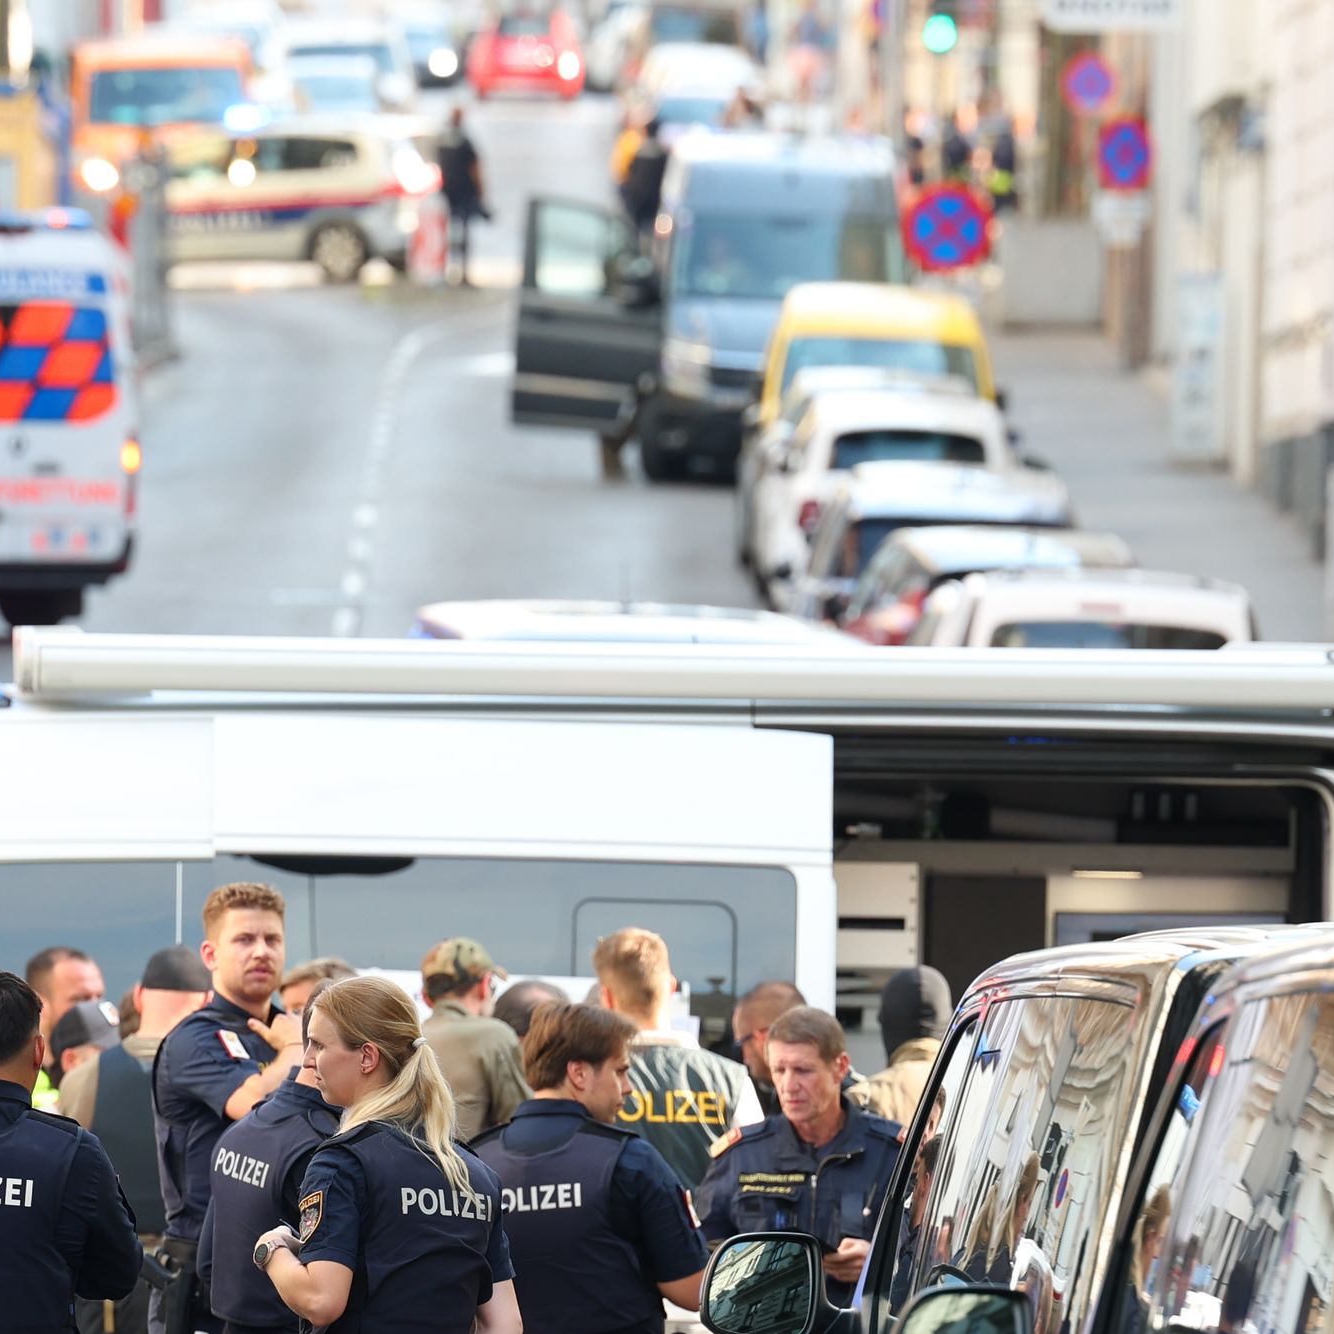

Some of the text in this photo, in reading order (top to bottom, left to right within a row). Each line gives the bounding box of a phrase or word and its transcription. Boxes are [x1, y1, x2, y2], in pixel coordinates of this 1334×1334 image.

[618, 1089, 726, 1124] OLIZEI
[214, 1147, 269, 1188] POLIZEI
[400, 1187, 492, 1222] POLIZEI
[501, 1183, 582, 1213] OLIZEI
